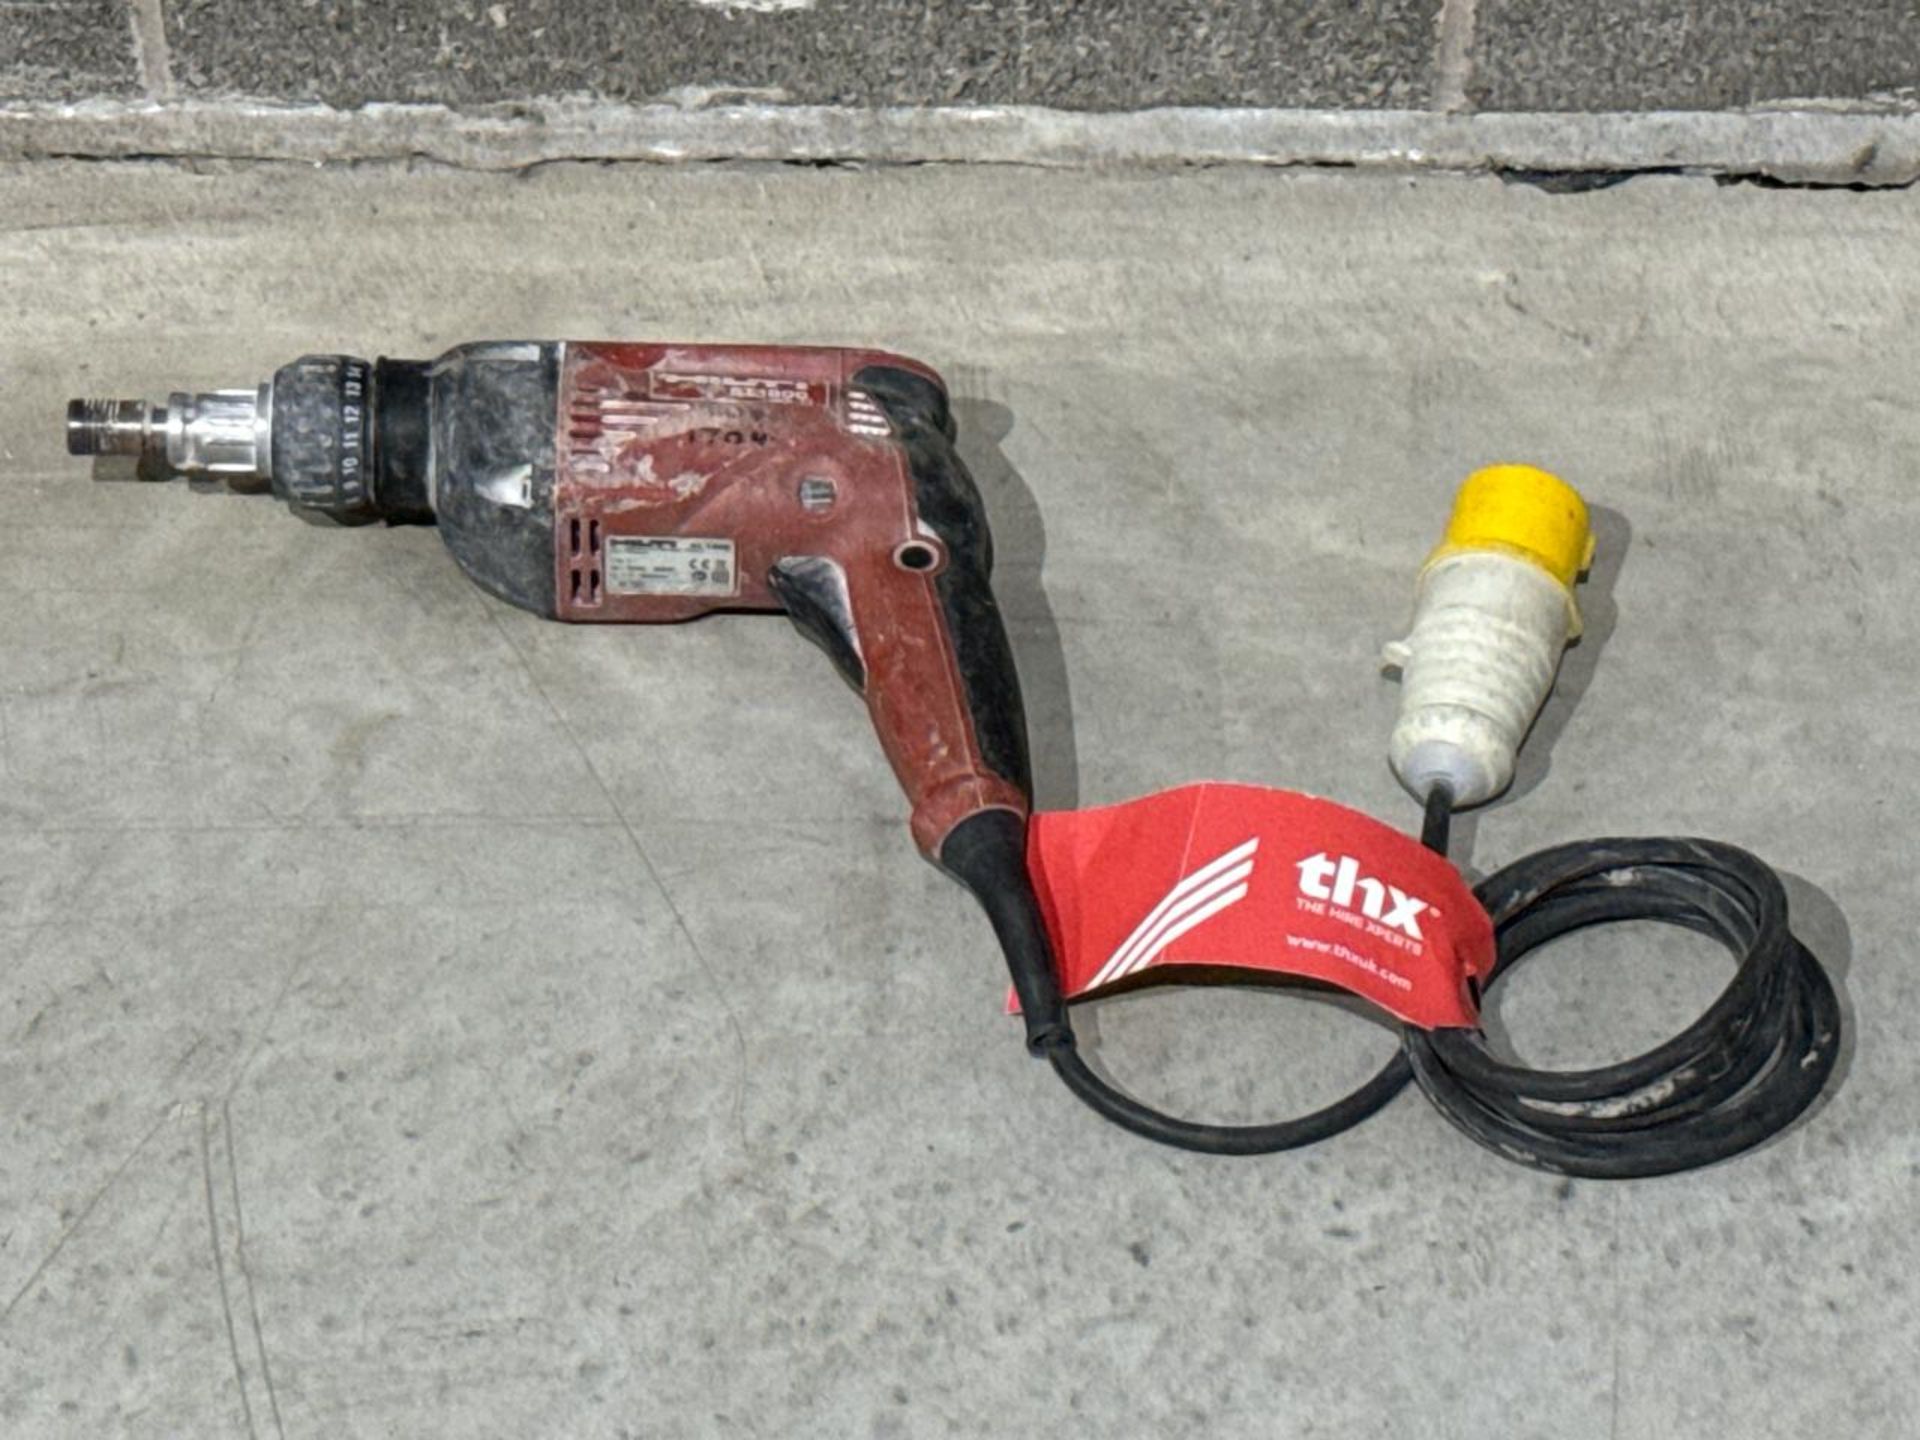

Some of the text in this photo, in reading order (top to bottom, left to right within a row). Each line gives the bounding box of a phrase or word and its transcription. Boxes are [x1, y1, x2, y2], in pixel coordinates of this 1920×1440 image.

[343, 404, 360, 423] 12
[342, 432, 359, 448] 11
[1296, 852, 1429, 940] thx
[1296, 897, 1325, 916] THE
[1329, 906, 1364, 930] HIRE
[1286, 934, 1413, 992] www.thxuk.com
